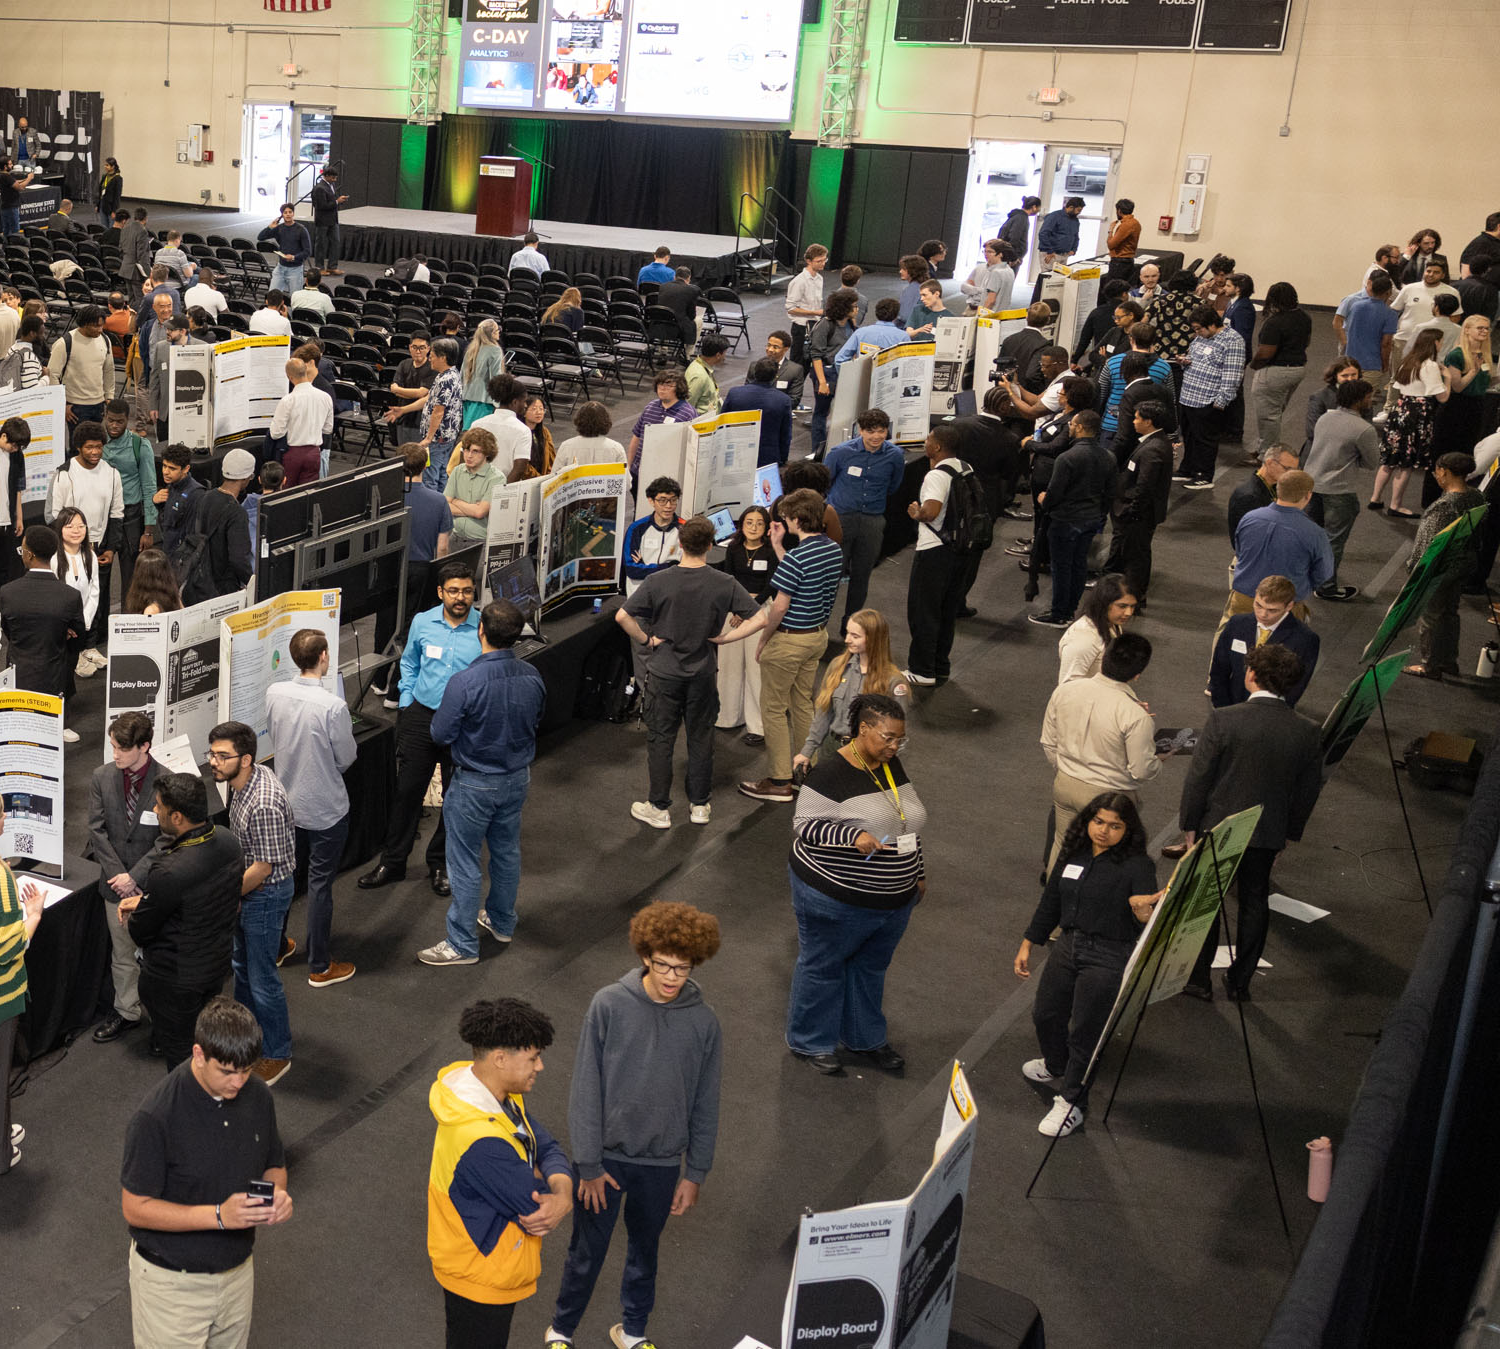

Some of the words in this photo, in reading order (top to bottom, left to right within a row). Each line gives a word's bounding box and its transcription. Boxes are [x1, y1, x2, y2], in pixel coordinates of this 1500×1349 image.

[476, 8, 506, 19] social
[505, 8, 528, 21] good
[473, 28, 530, 44] C-DAY
[469, 50, 508, 58] ANALYTICS
[1040, 88, 1059, 101] EXIT
[21, 201, 43, 210] KENNESAW
[21, 205, 55, 215] UNIVERSITY
[574, 479, 604, 488] Exclusive:
[577, 488, 605, 496] Defense
[182, 663, 194, 672] HEAVY
[194, 660, 204, 668] DUTY
[182, 667, 202, 680] Tri-Fold
[202, 662, 220, 673] Display
[112, 680, 136, 690] Display
[26, 698, 52, 709] (STEDR)
[879, 1218, 893, 1227] Life
[824, 1230, 887, 1242] www.elmers.com
[796, 1323, 840, 1340] Display
[841, 1320, 878, 1335] Board
